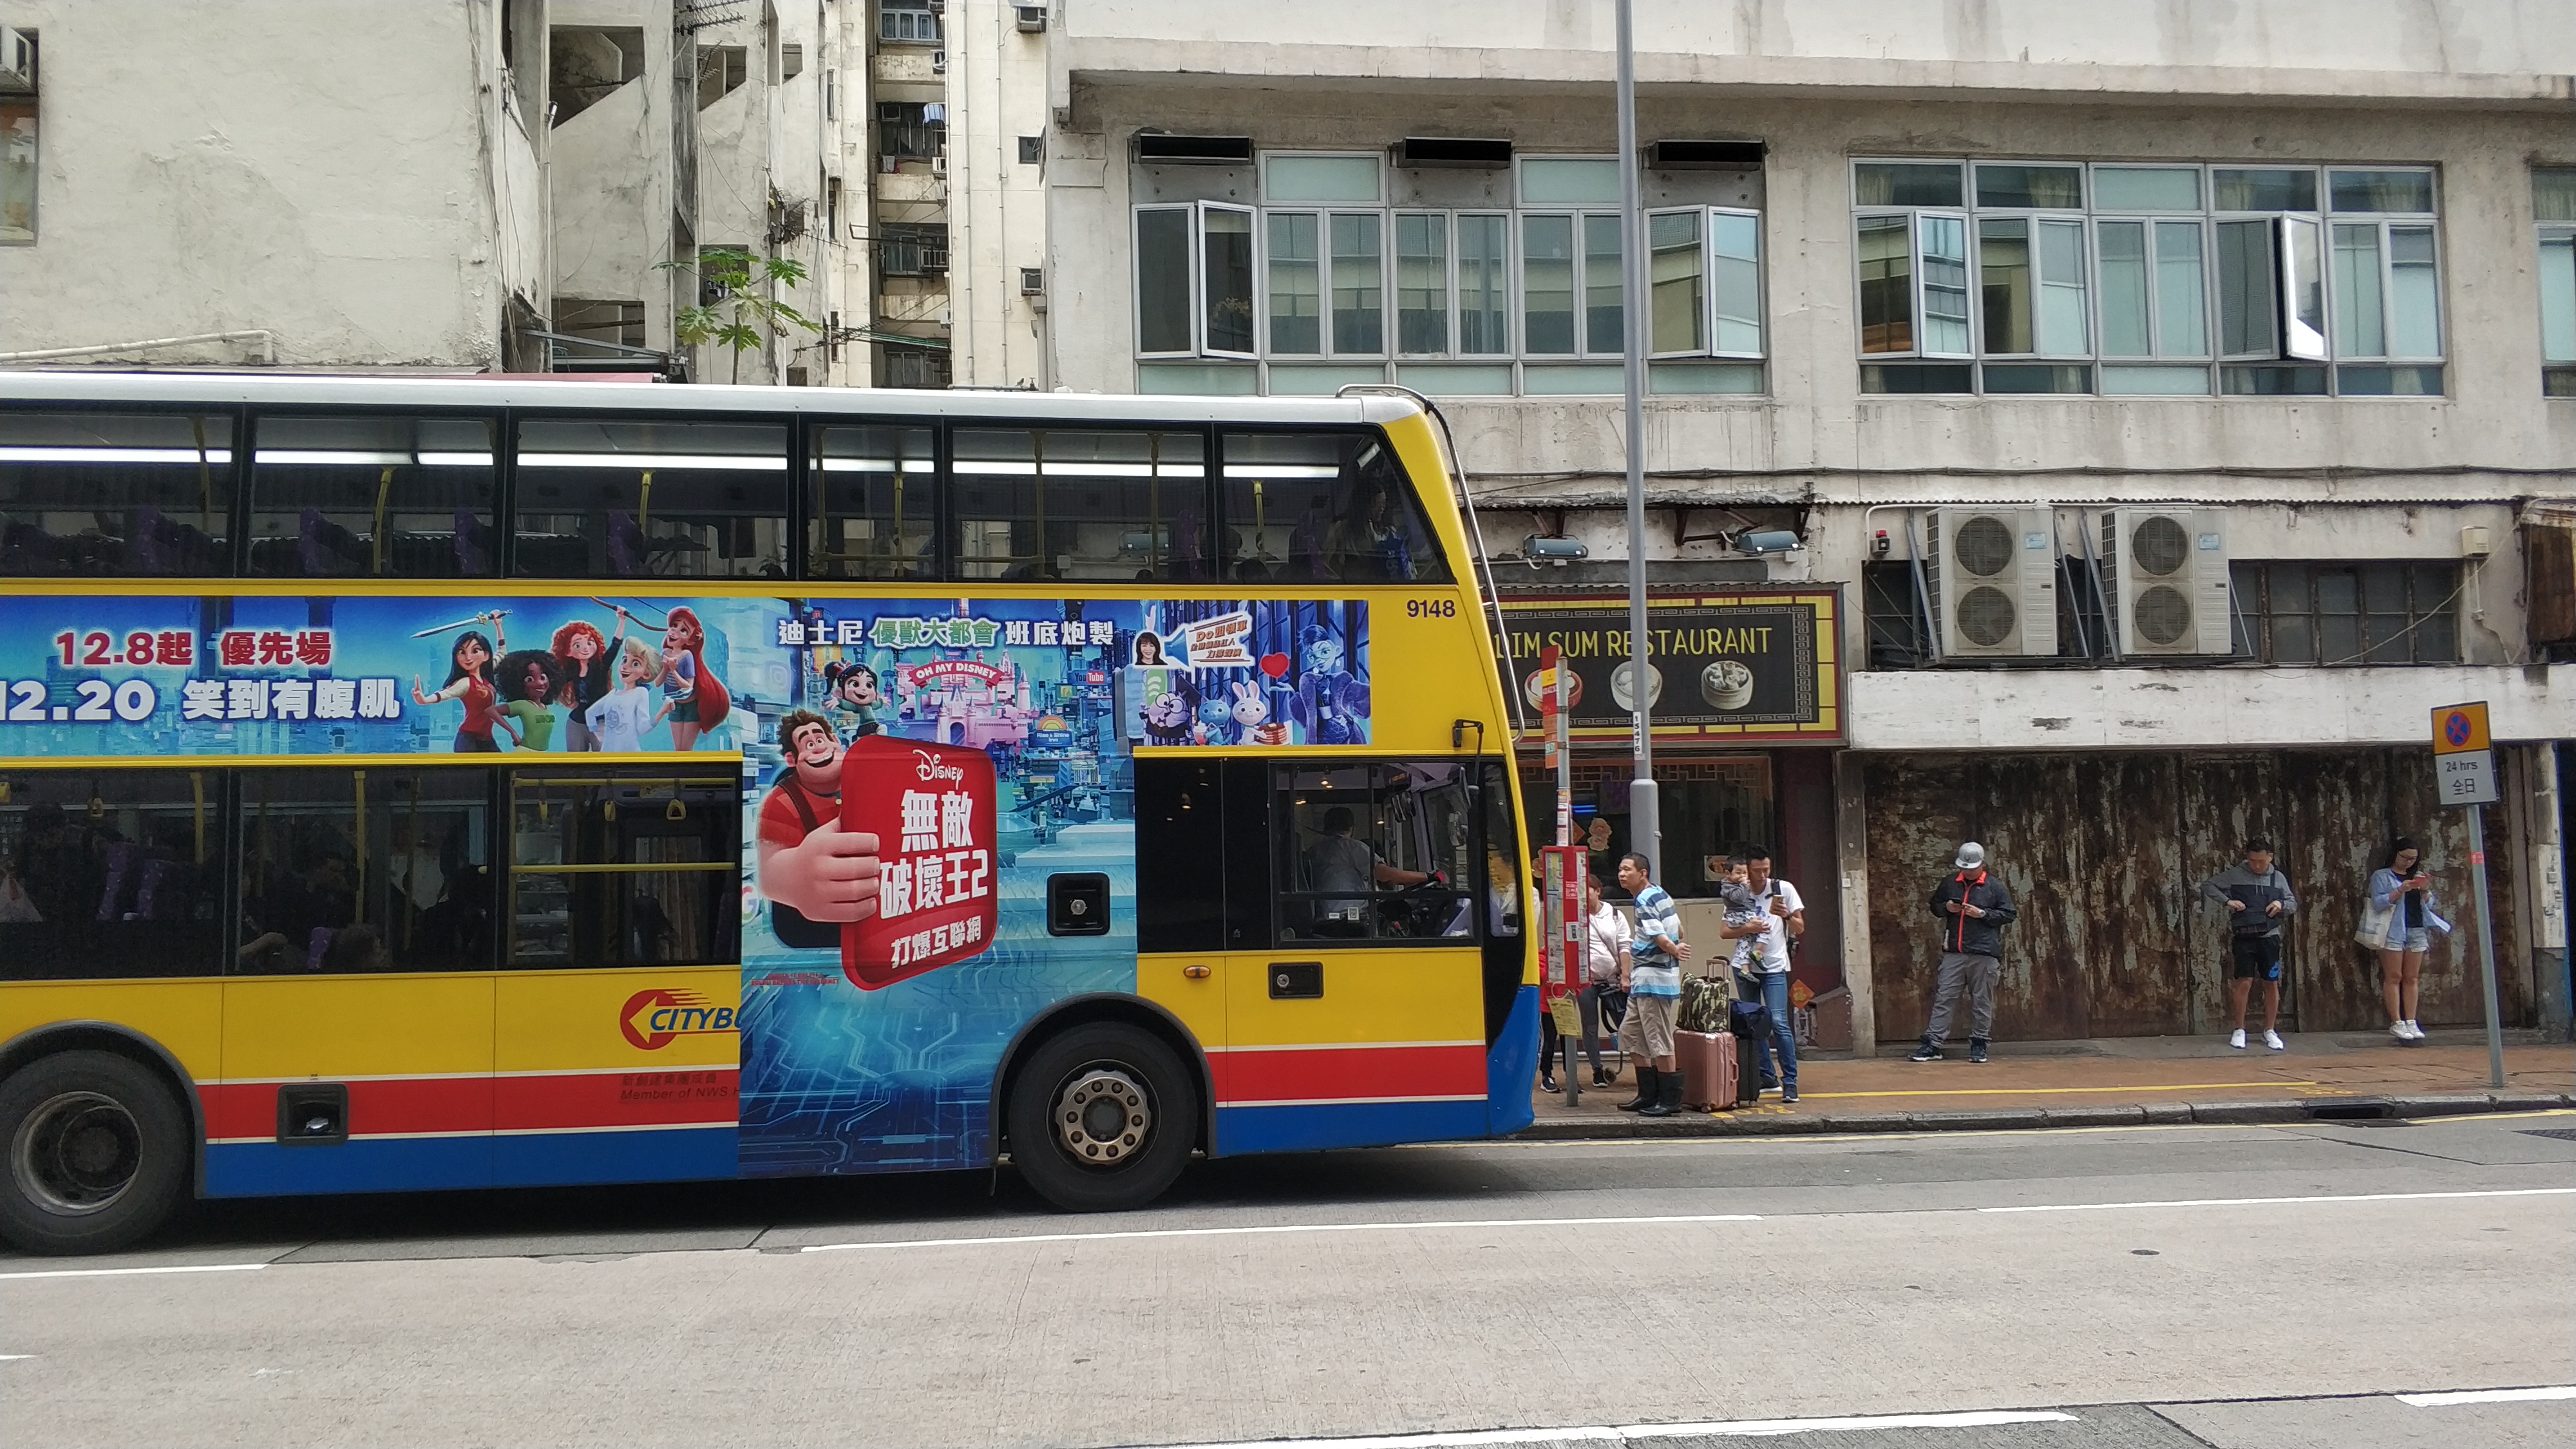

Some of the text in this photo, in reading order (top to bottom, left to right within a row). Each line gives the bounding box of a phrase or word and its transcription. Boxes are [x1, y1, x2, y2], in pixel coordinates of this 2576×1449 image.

[1406, 600, 1456, 618] 9148
[779, 618, 1113, 647] 迪士尼 優獸大都會 班底炮製
[1548, 630, 1599, 658] SUM
[56, 631, 332, 665] 12.8起 優先場
[916, 663, 998, 679] OH MY DISNEY
[1074, 672, 1104, 682] YouTube
[182, 679, 401, 721] 笑到有腹肌
[2446, 761, 2478, 772] 24 hrs
[2452, 777, 2476, 795] 全日
[900, 789, 974, 853] 無敵
[878, 849, 989, 920] 破壞王2
[890, 914, 982, 969] 打爆互聯網
[621, 1089, 674, 1100] Member
[678, 1088, 692, 1099] of
[696, 1086, 728, 1097] NWS
